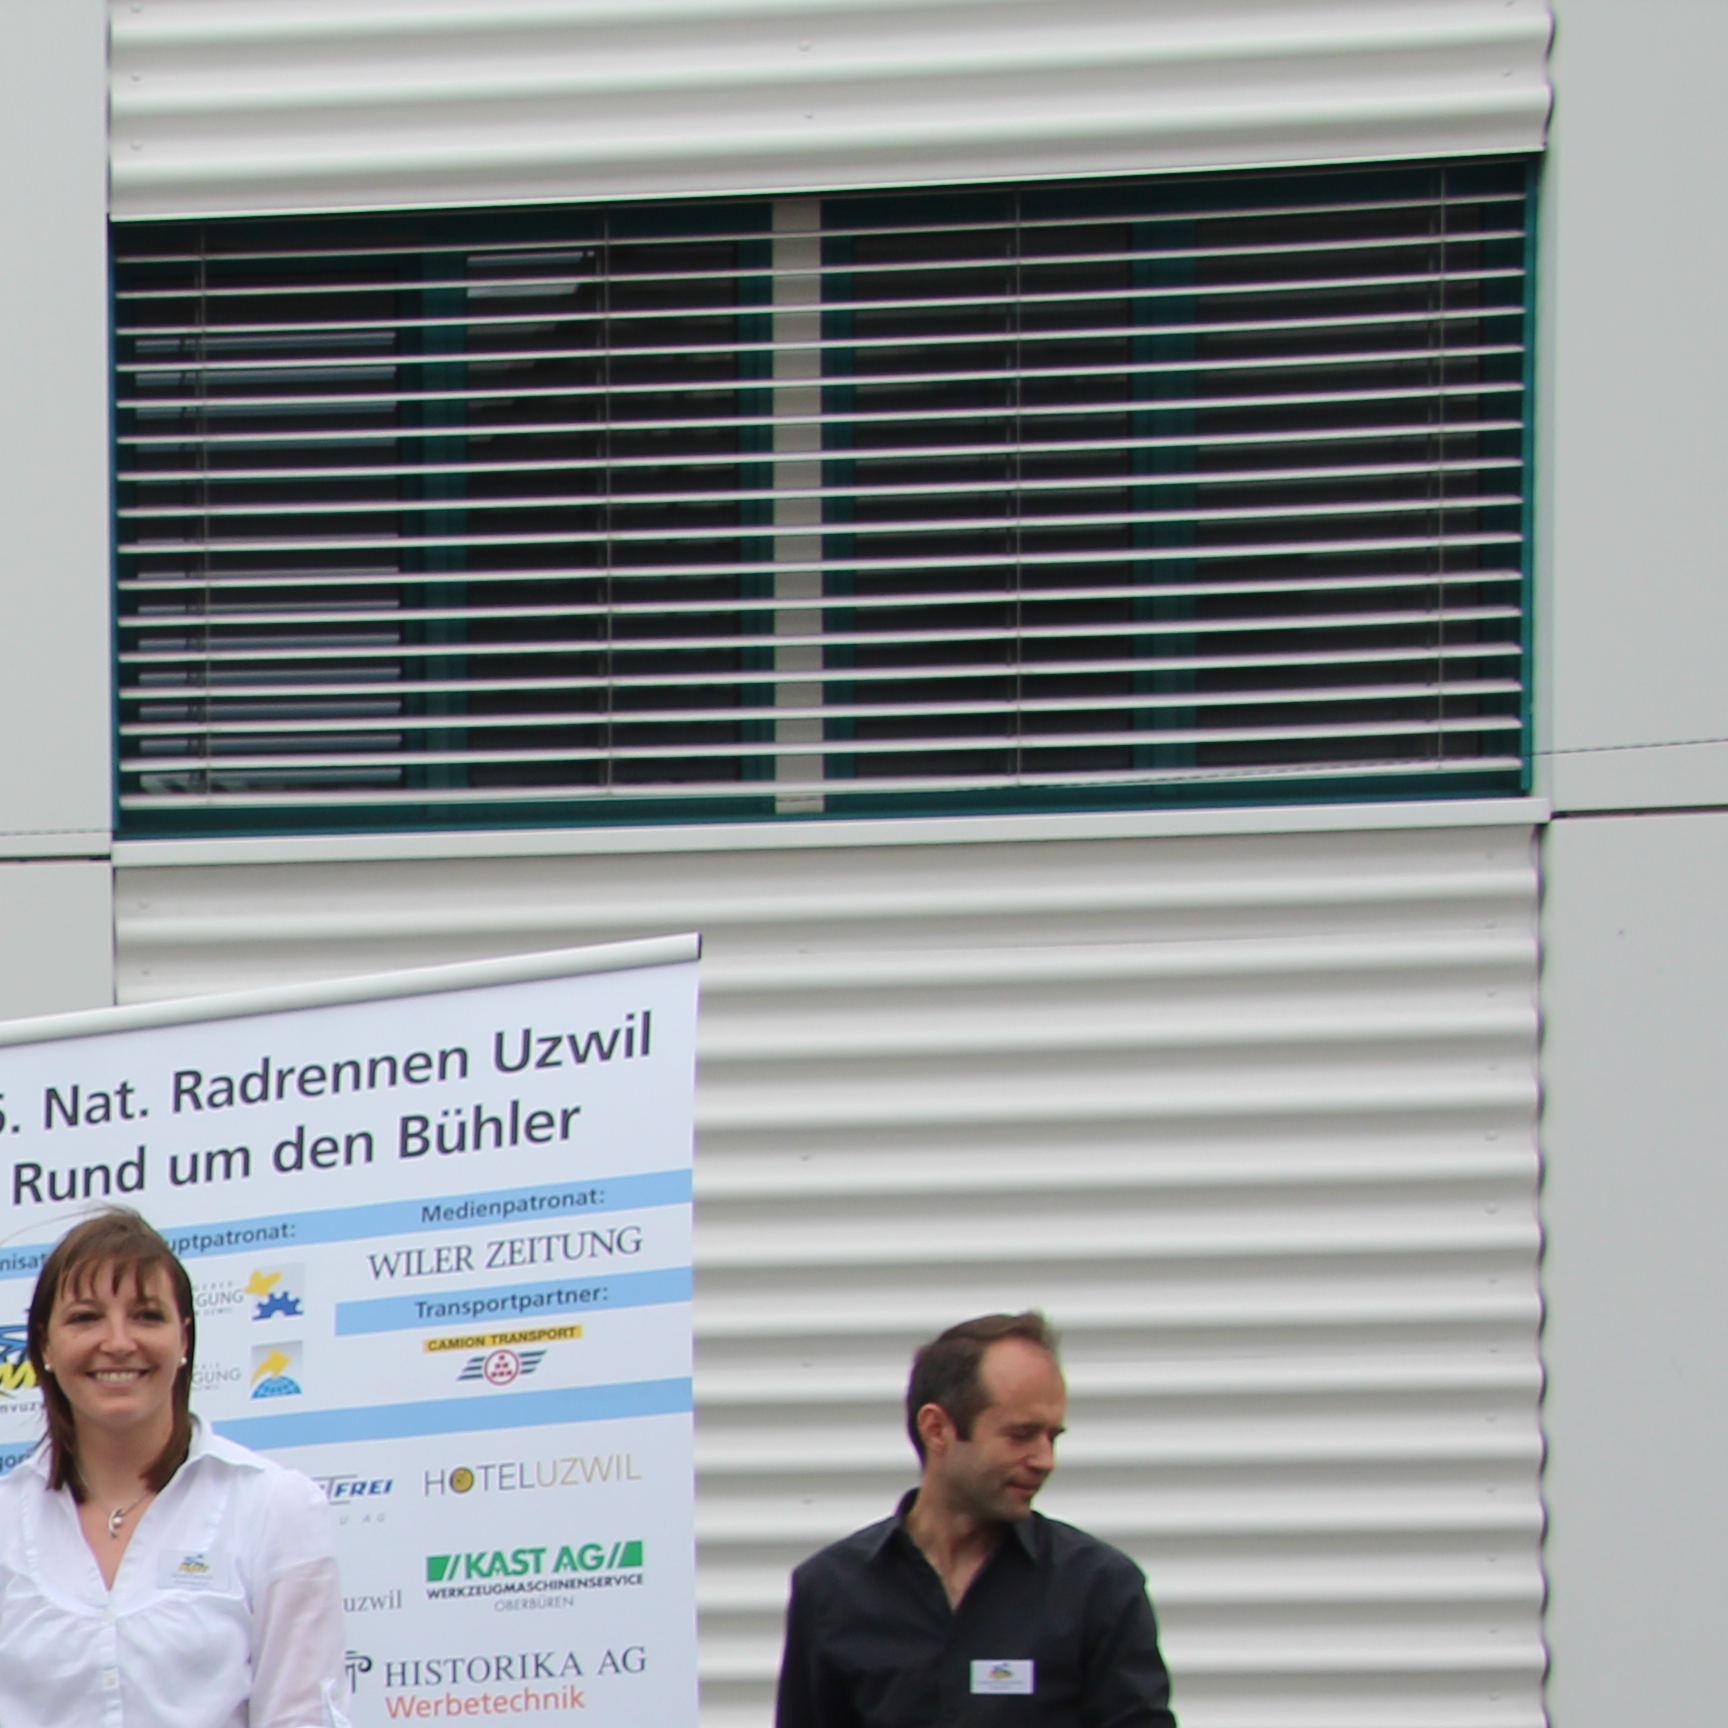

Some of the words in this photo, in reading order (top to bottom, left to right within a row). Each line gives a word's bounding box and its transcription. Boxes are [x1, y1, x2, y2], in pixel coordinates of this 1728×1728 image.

[43, 1078, 149, 1133] Nat.
[171, 1045, 469, 1114] Radrennen
[492, 1011, 653, 1075] Uzwil
[12, 1146, 146, 1205] Rund
[169, 1137, 252, 1187] um
[271, 1112, 375, 1173] den
[399, 1100, 581, 1158] Bühler
[421, 1189, 605, 1223] Medienpatronat:
[166, 1222, 296, 1255] uptpatronat:
[367, 1244, 475, 1280] WILER
[485, 1226, 643, 1270] ZEITUNG
[415, 1286, 609, 1319] Transportpartner:
[427, 1335, 485, 1351] CAMION
[491, 1327, 577, 1345] TRANSPORT
[464, 1547, 547, 1581] KAST
[552, 1542, 608, 1574] AG
[343, 1589, 404, 1613] uzwil
[426, 1573, 644, 1601] WERKZEUGMASCHINENSERVICE
[493, 1594, 575, 1613] OBERBÜREN
[384, 1650, 584, 1688] HISTORIKA
[597, 1645, 647, 1676] AG
[385, 1684, 586, 1719] Werbetechnik
